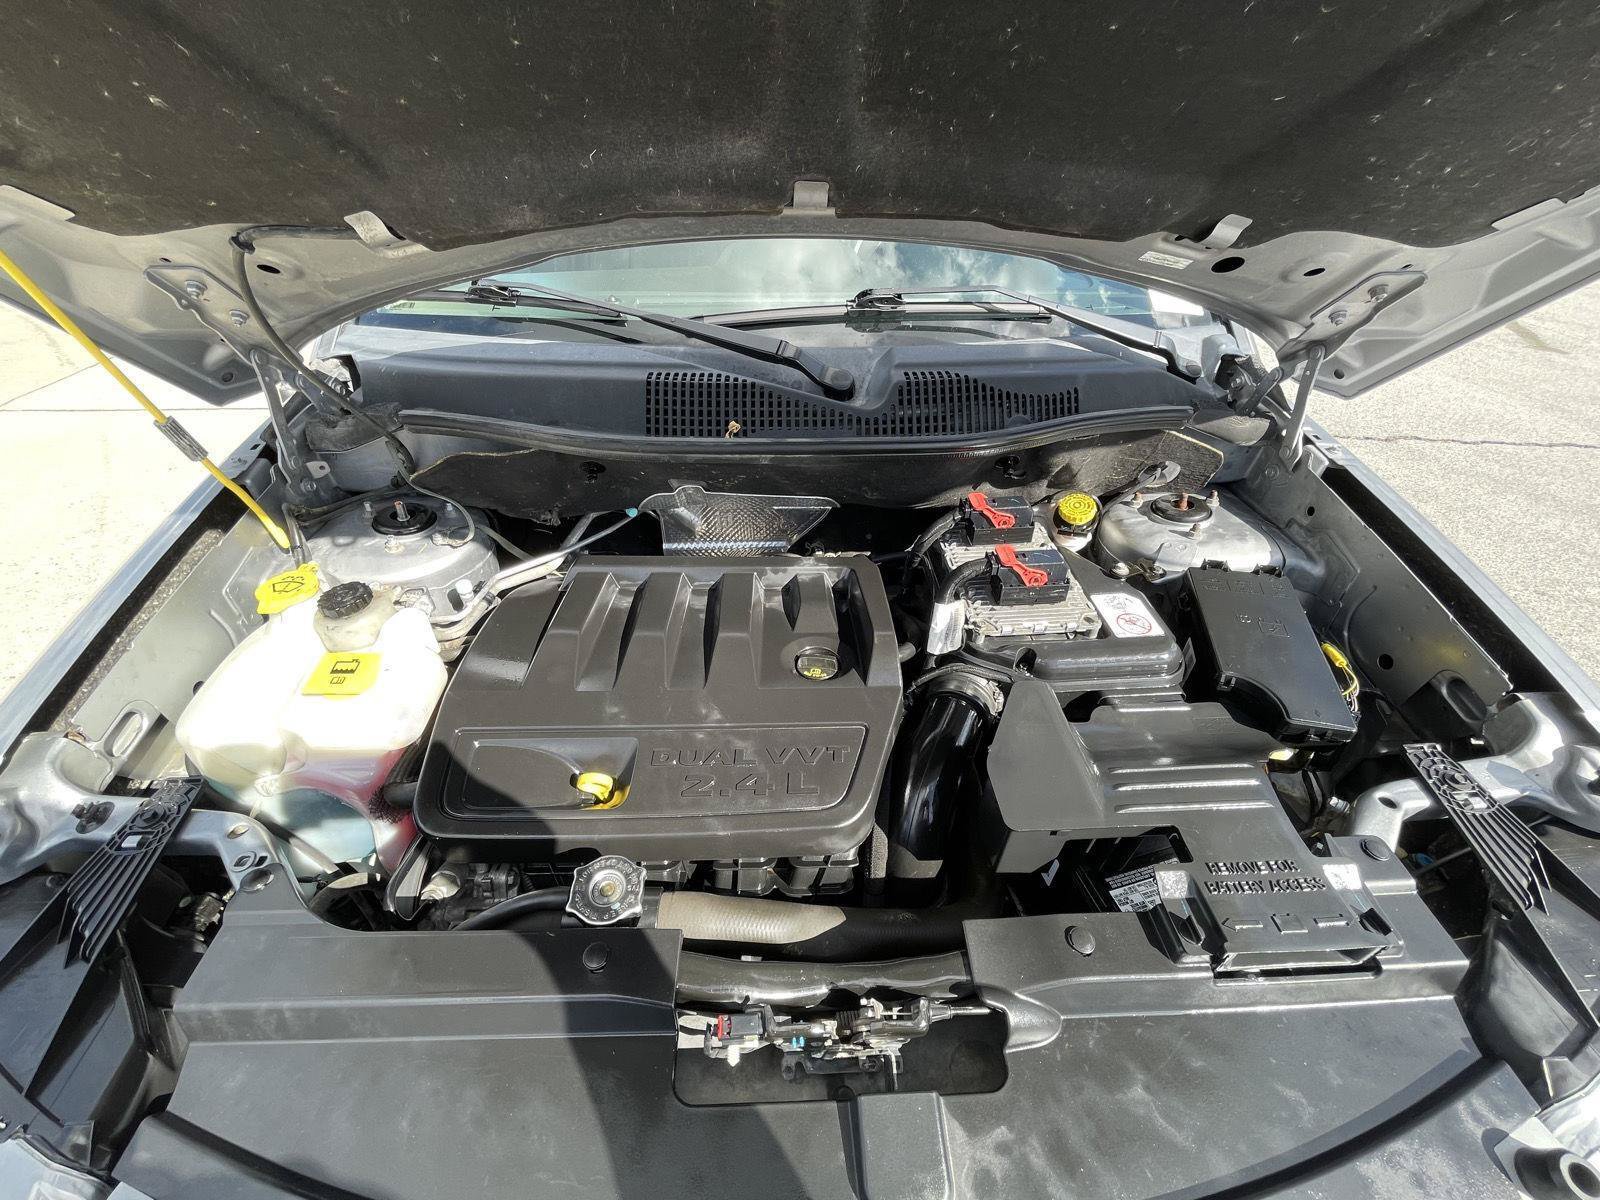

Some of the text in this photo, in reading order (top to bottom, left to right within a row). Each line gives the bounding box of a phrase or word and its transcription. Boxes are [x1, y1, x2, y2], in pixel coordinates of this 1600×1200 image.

[650, 746, 850, 767] DUAL VVT
[1204, 859, 1301, 875] REMOVE FOR
[1203, 877, 1327, 895] BATTERY ACCESS
